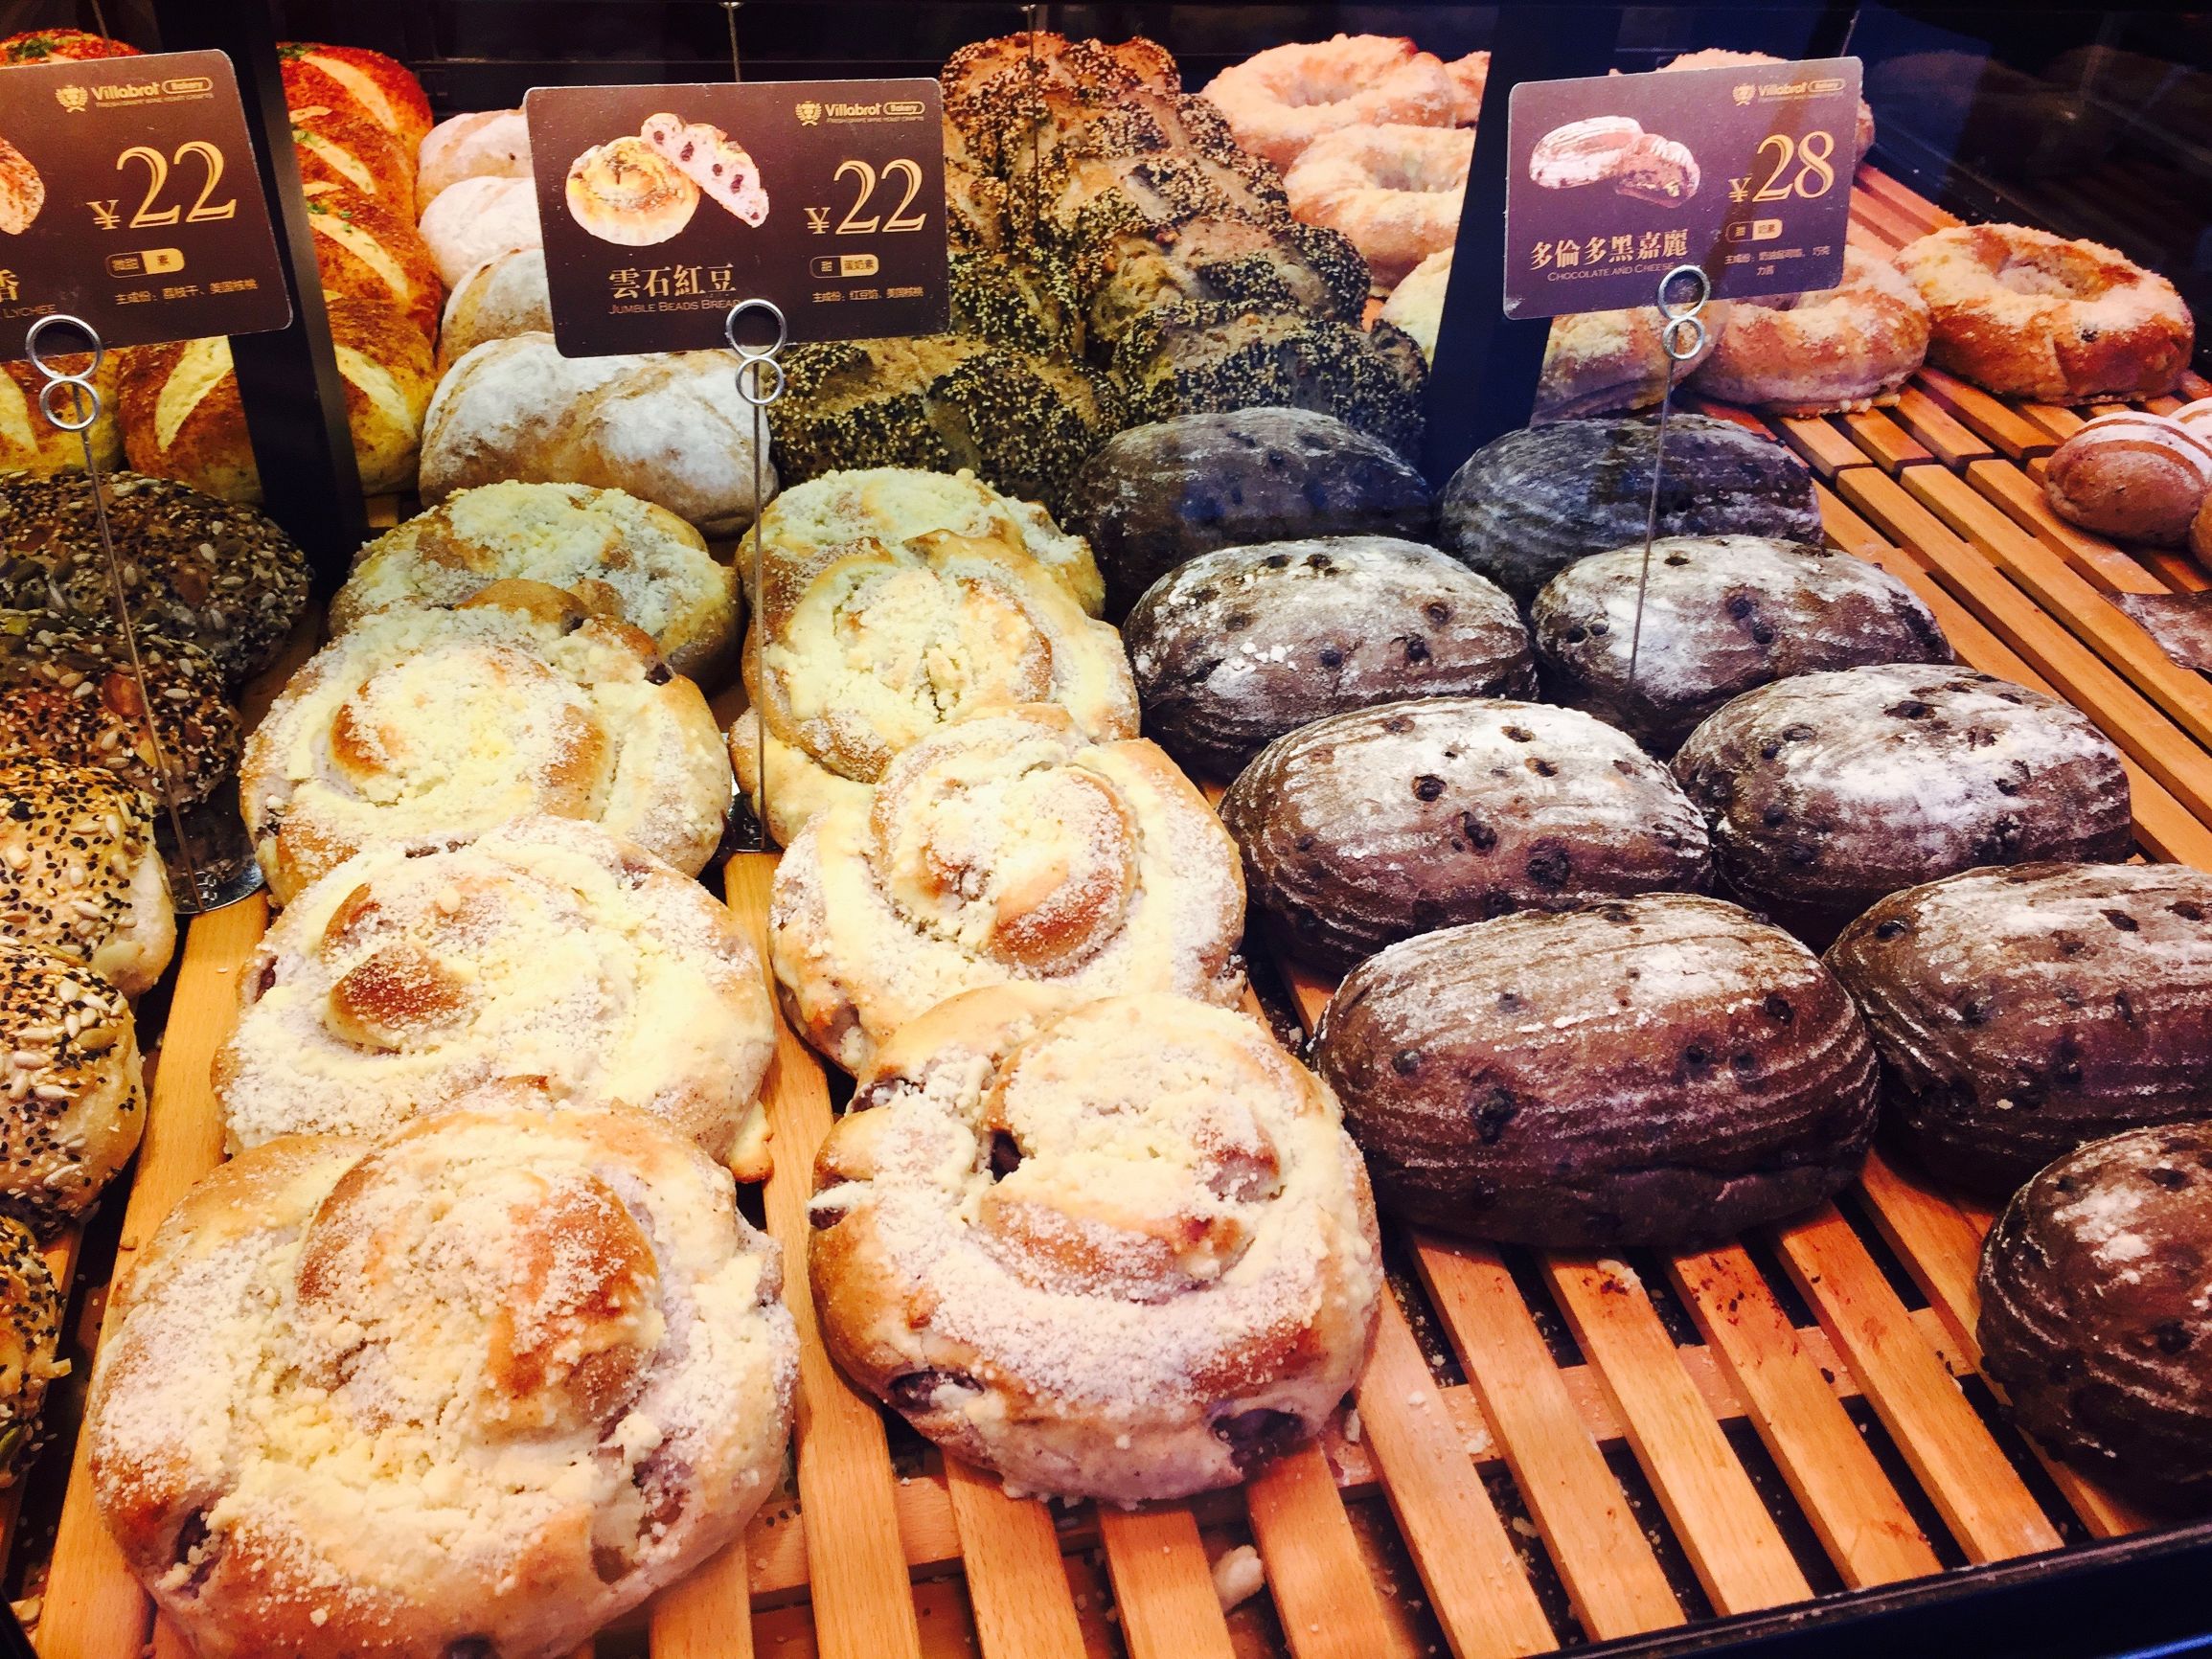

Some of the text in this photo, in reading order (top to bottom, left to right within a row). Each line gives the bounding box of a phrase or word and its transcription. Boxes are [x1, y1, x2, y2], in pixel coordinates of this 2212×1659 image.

[825, 102, 881, 116] Villabrot
[1530, 228, 1689, 271] 多倫多黑嘉麗
[608, 262, 737, 299] 雲石紅豆
